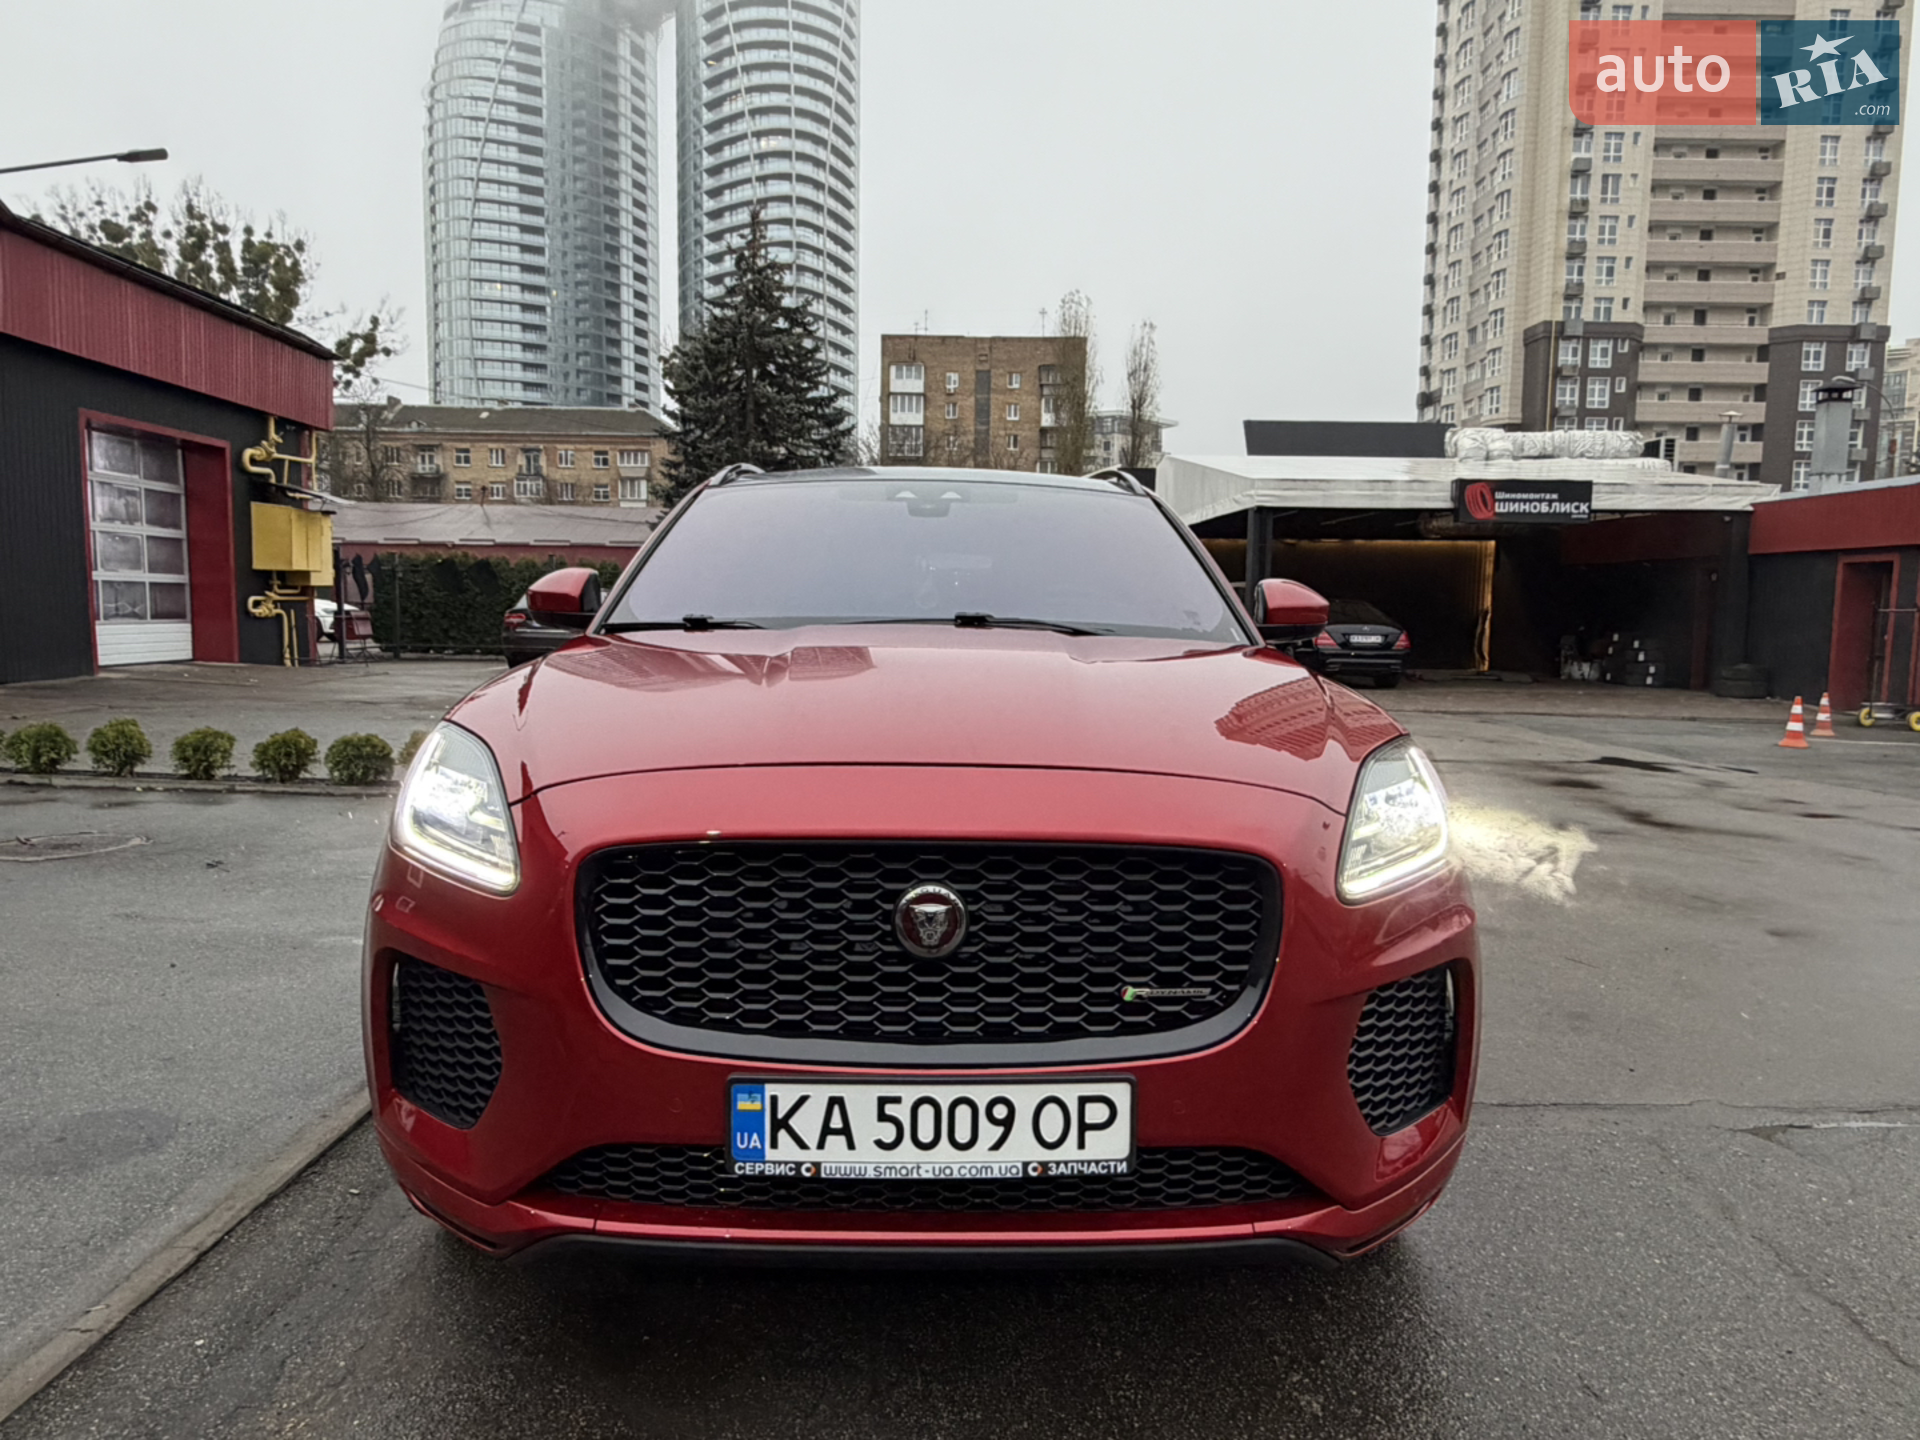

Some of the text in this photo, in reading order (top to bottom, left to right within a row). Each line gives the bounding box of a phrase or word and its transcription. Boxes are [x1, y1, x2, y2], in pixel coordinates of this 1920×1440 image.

[1494, 491, 1559, 500] Шиномонтаж
[1494, 501, 1590, 514] ШИНОБЛИСК
[769, 1094, 1118, 1151] KA 5009 OP
[736, 1132, 762, 1150] UA
[734, 1162, 796, 1176] СЕРВИС
[823, 1163, 1021, 1178] www.smart-ua.com.ua
[1047, 1161, 1128, 1176] ЗАПЧАСТИ
